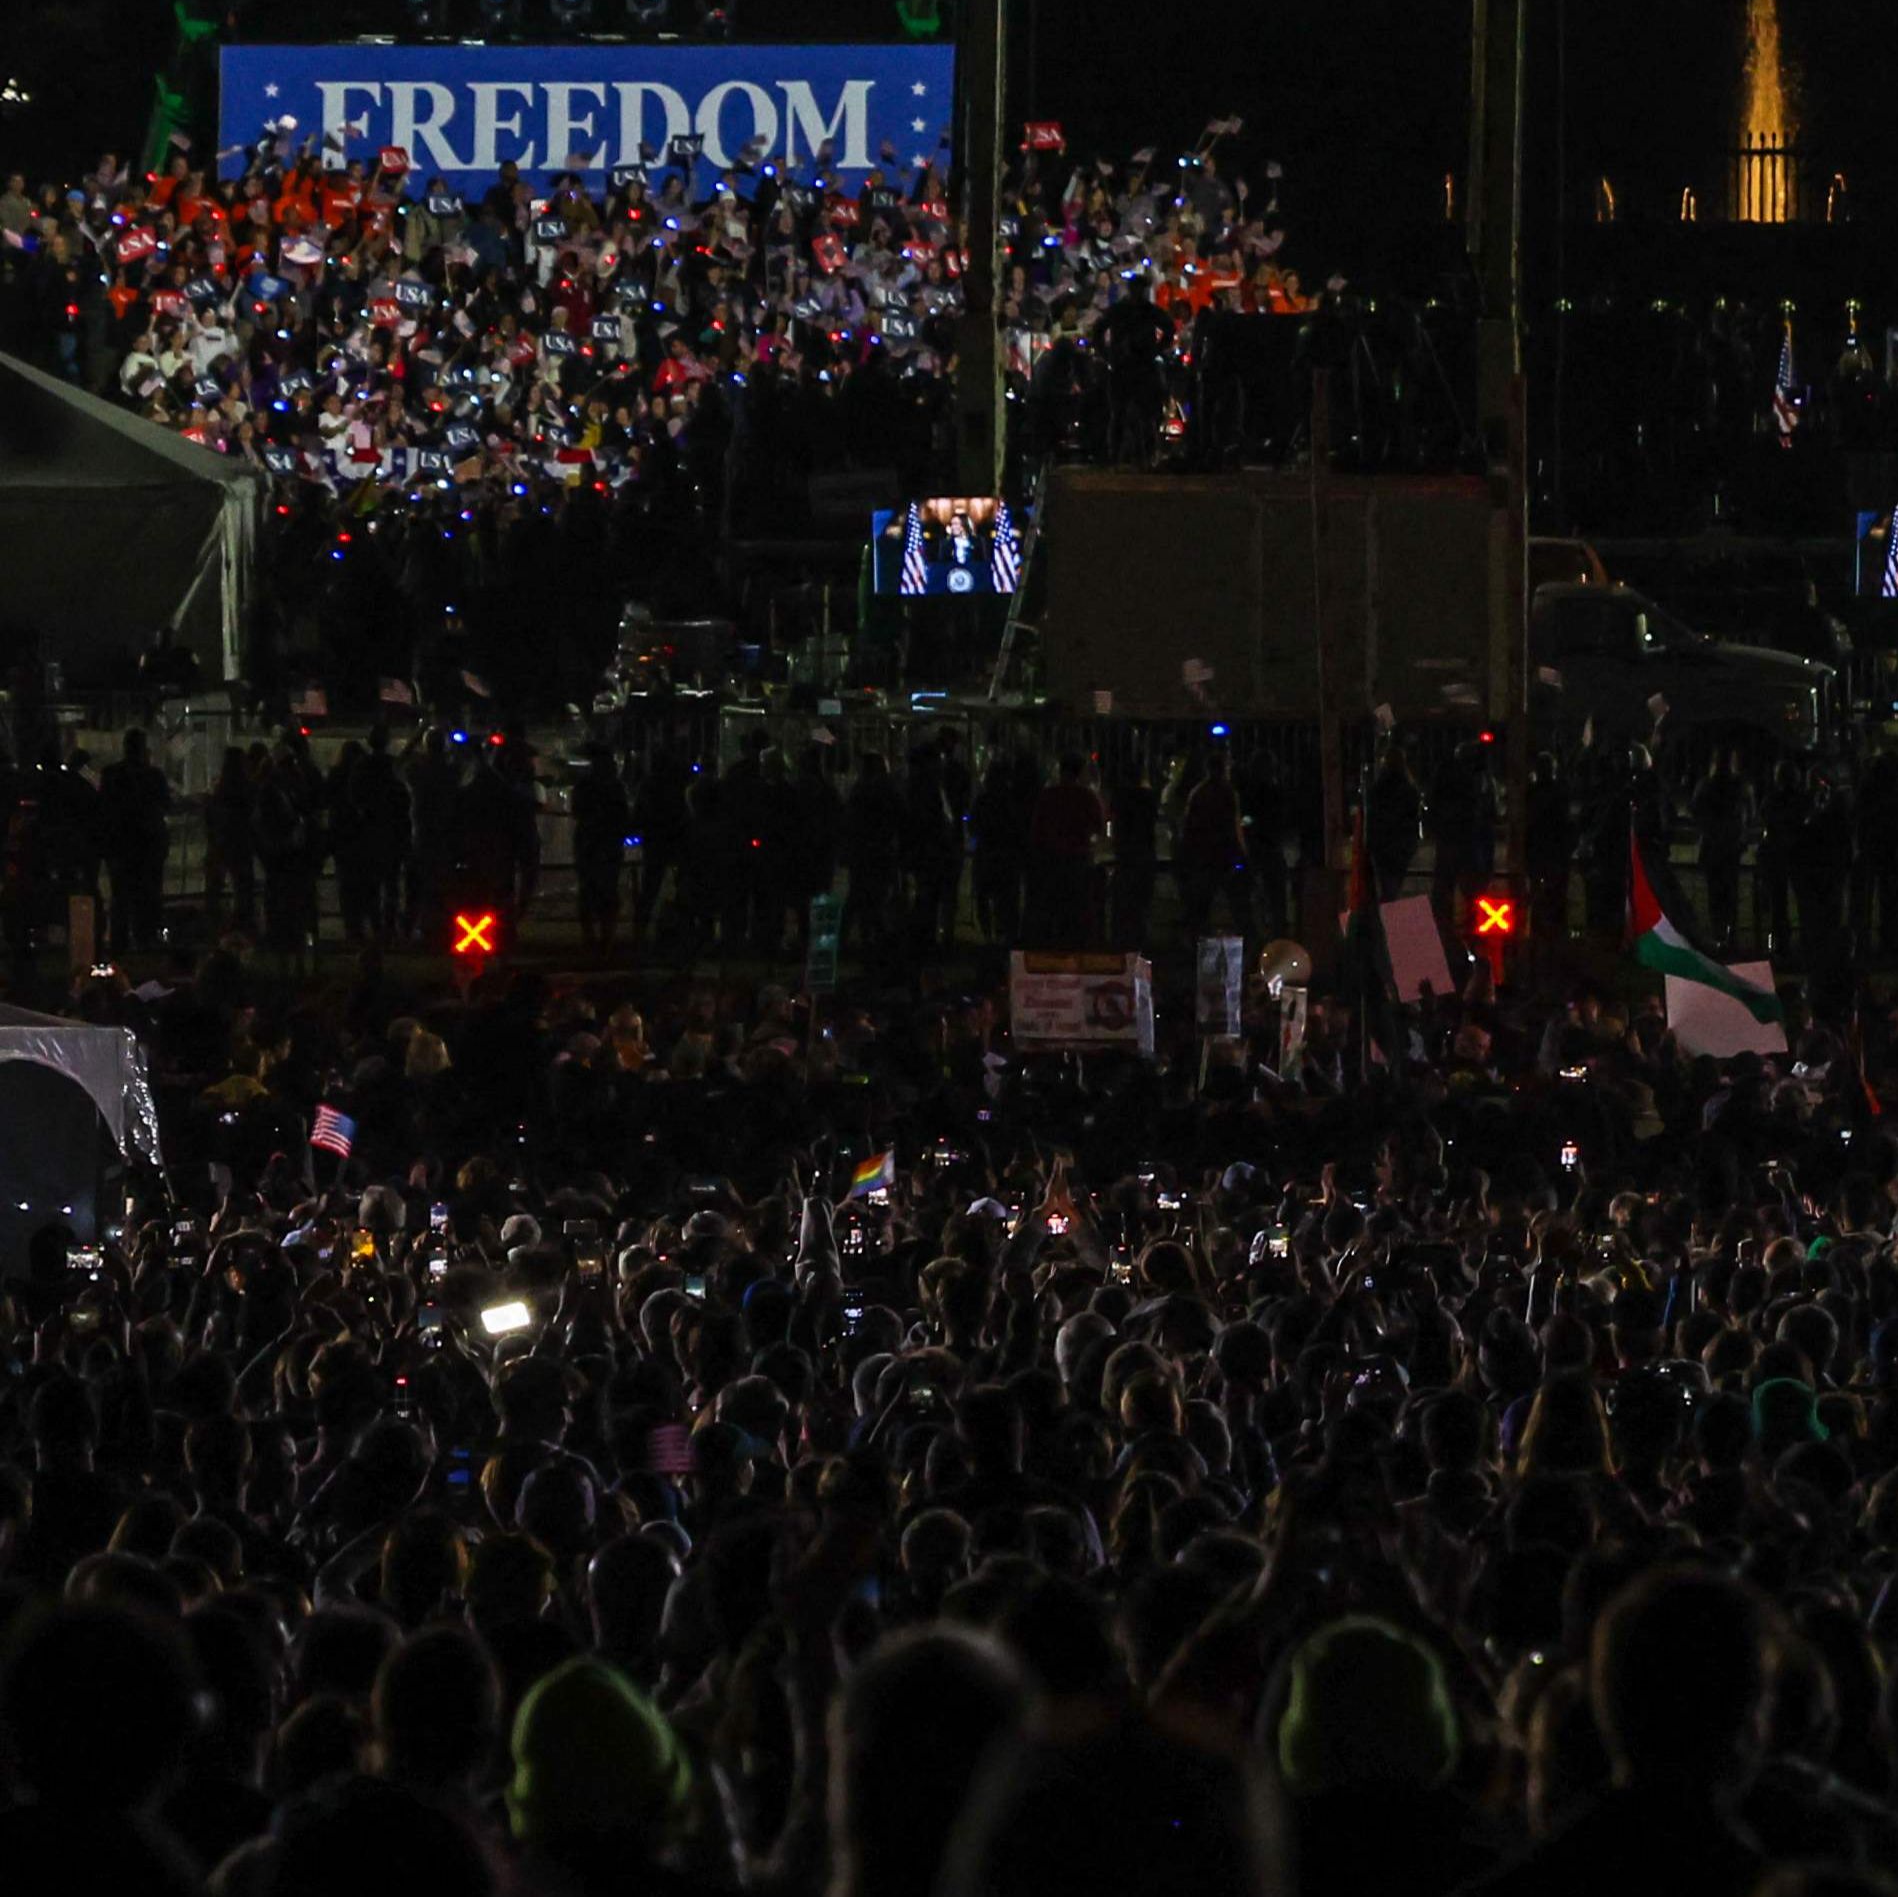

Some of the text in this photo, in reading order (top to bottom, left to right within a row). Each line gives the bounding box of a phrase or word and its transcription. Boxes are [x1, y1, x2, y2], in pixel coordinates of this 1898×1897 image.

[314, 80, 876, 172] FREEDOM
[613, 168, 646, 186] USA
[430, 196, 462, 212] USA
[836, 207, 858, 220] SA
[538, 222, 565, 237] USA
[396, 284, 428, 305] USA
[887, 290, 909, 306] US
[795, 298, 821, 317] SA
[592, 322, 622, 338] USA
[882, 317, 915, 337] USA
[545, 335, 576, 351] USA
[196, 379, 220, 395] US
[446, 427, 480, 446] USA
[267, 454, 294, 471] SA
[420, 451, 449, 469] USA
